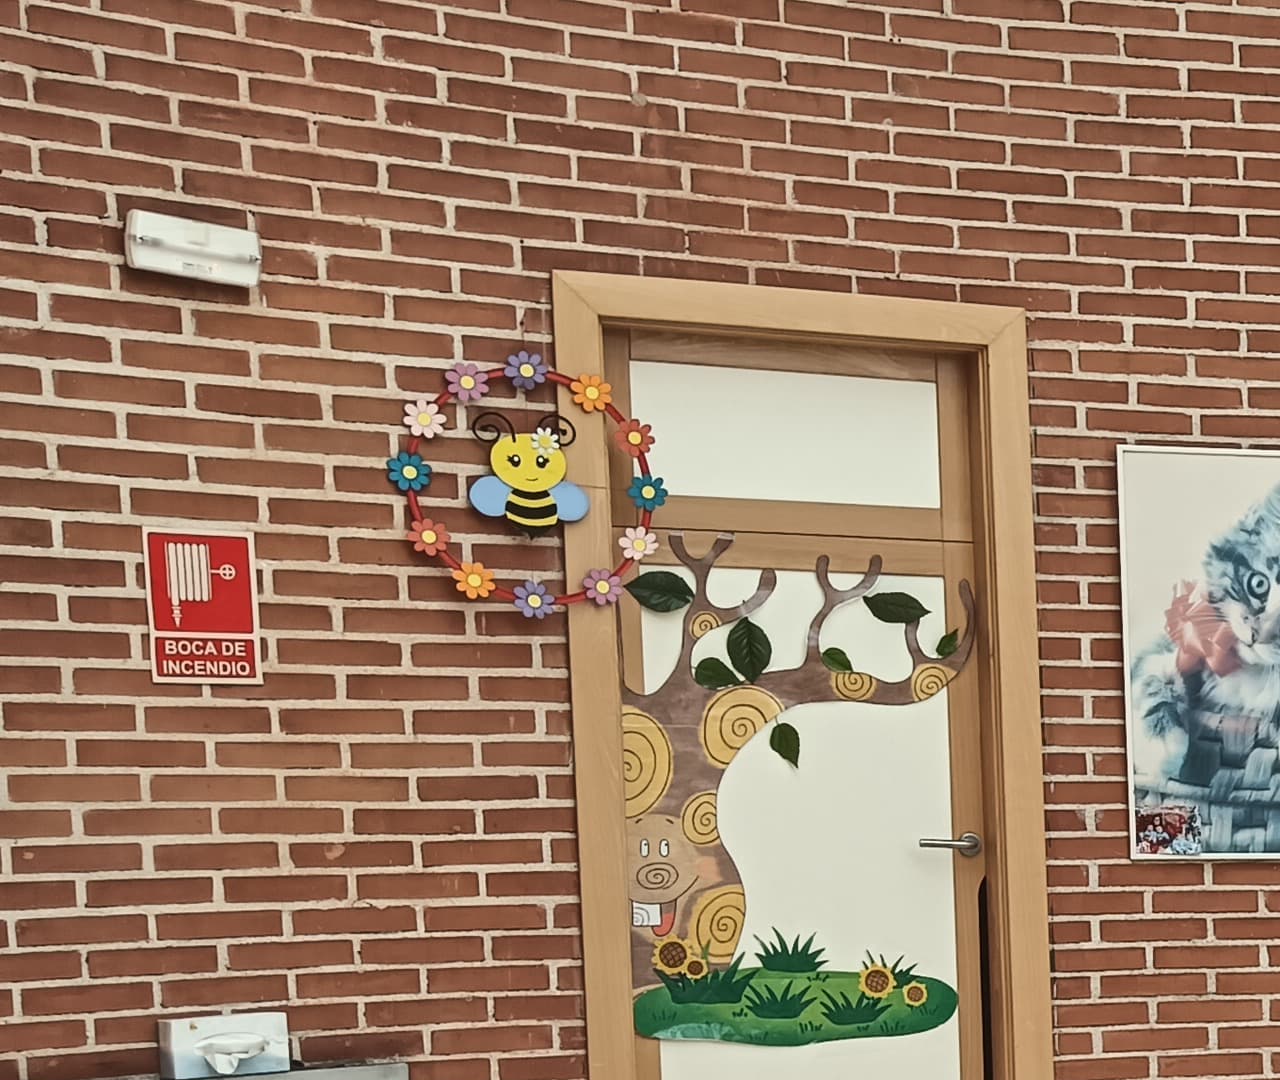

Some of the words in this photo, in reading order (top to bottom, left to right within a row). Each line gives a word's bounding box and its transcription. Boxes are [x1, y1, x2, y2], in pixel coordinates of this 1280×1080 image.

[164, 640, 218, 656] BOCA
[221, 641, 247, 656] DE
[163, 660, 250, 675] INCENDIO
